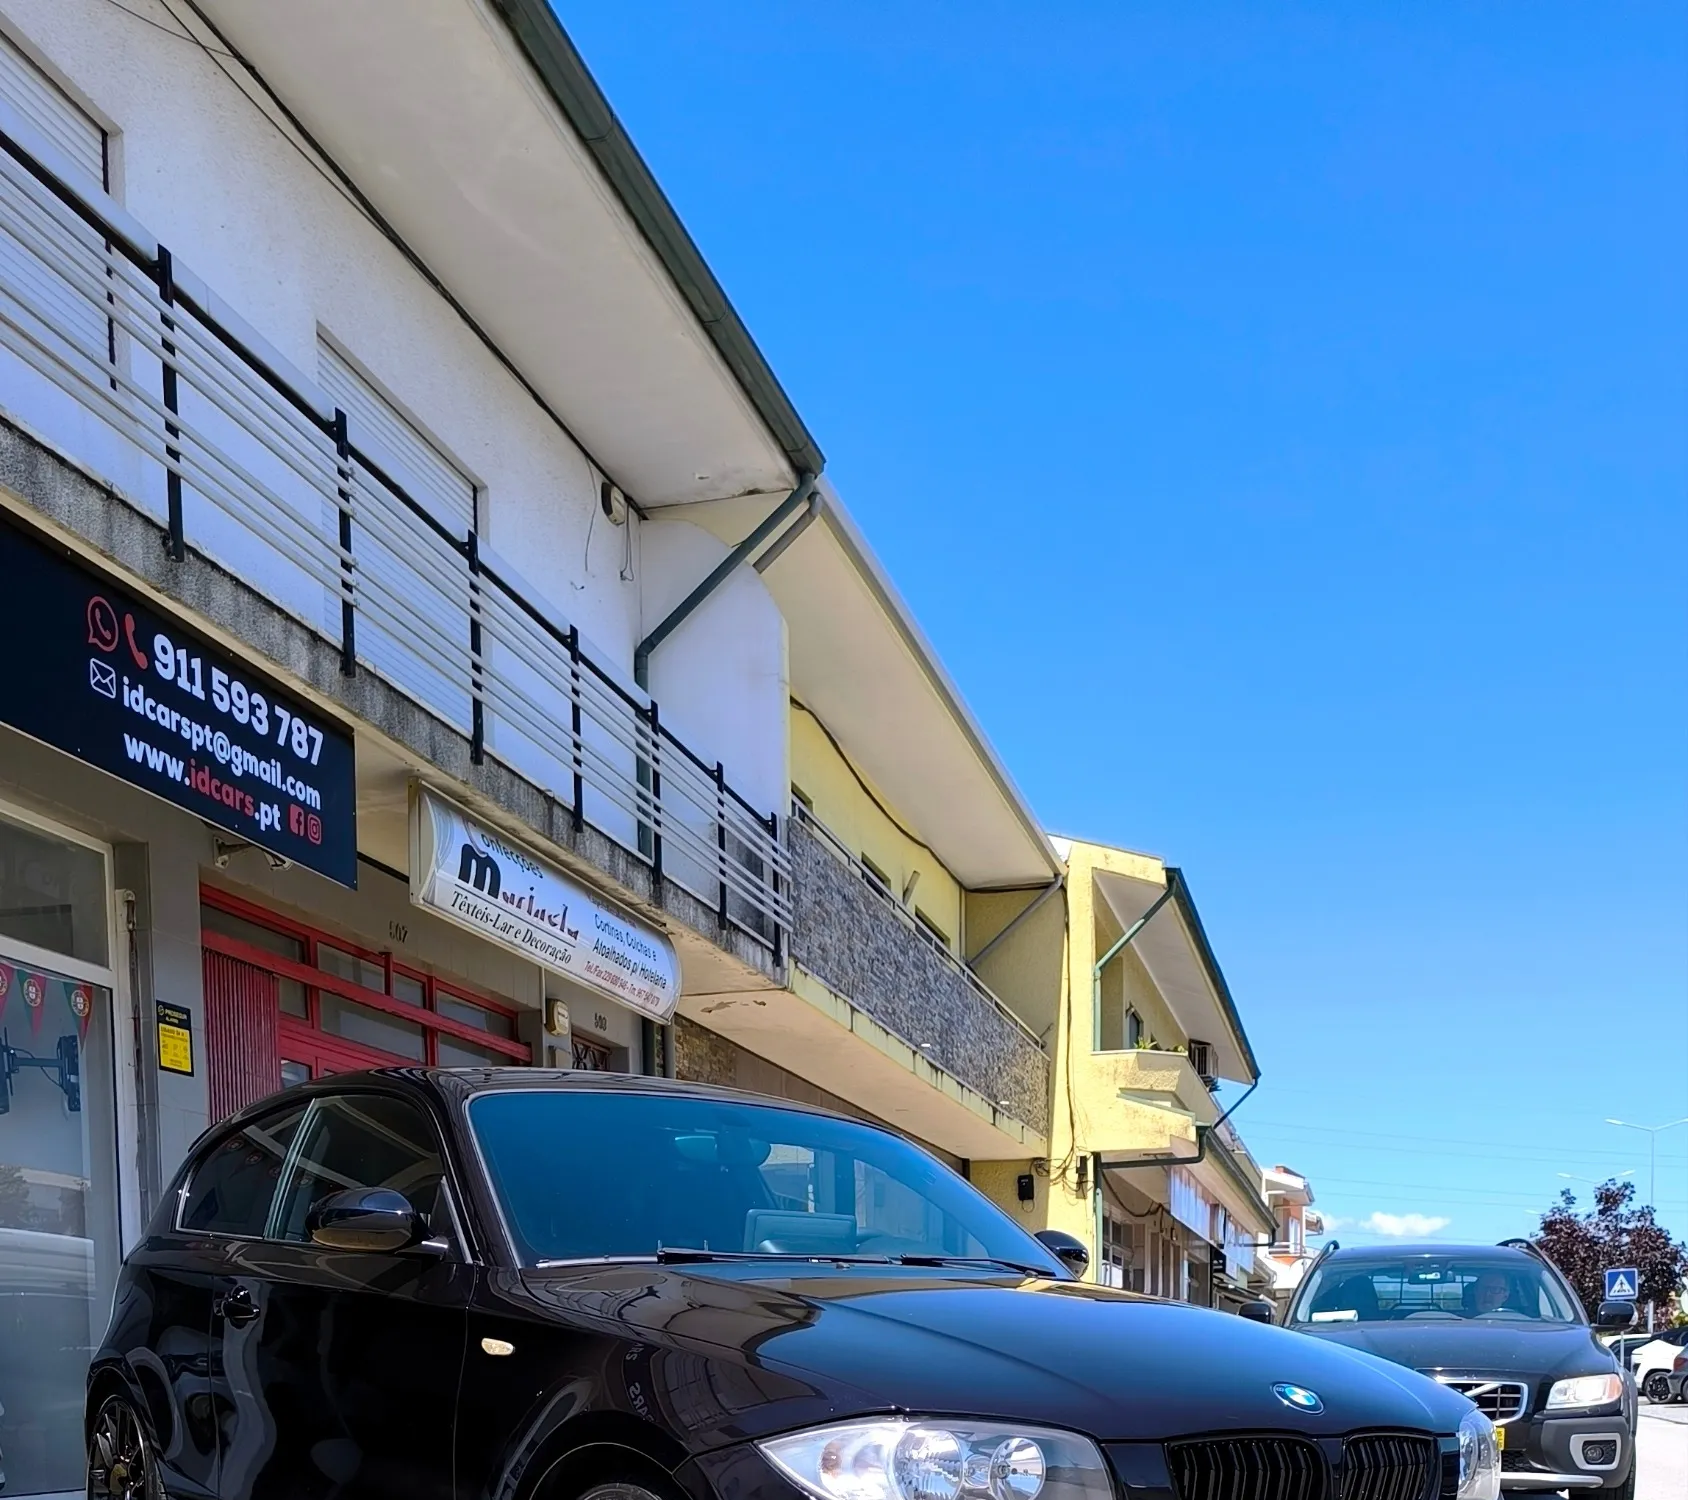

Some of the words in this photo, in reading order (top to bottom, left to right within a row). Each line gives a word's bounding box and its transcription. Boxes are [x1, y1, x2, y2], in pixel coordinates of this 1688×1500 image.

[122, 676, 321, 810] idcarspt@gmail.com
[153, 633, 206, 702] 911
[211, 666, 269, 736] 593
[274, 703, 324, 766] 787
[123, 732, 282, 831] www.idcars.pt
[450, 890, 514, 936] Têxteis-Lar
[514, 926, 522, 939] e
[521, 927, 572, 965] Decoração
[592, 937, 632, 971] Atoalhados
